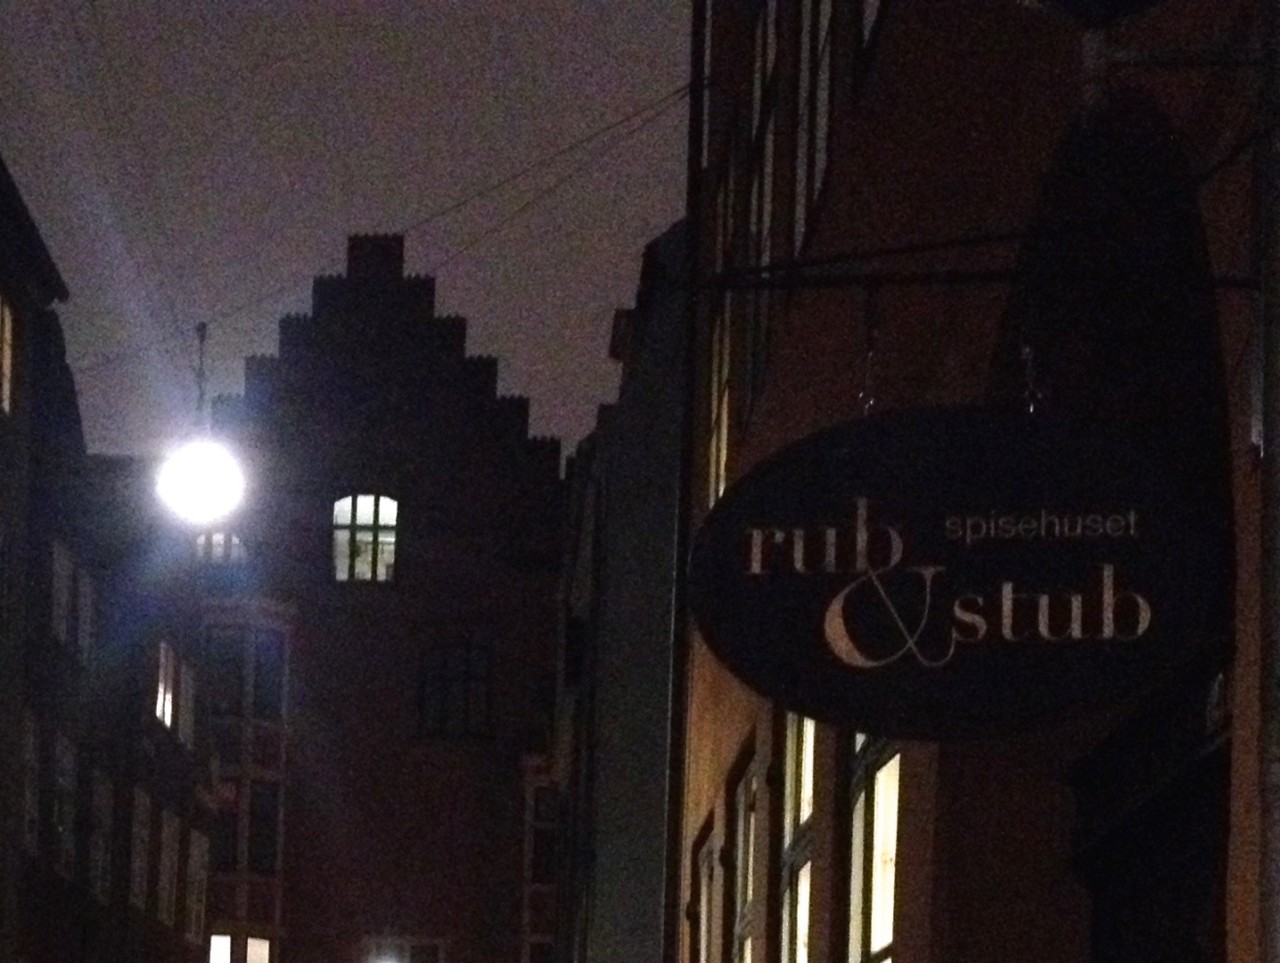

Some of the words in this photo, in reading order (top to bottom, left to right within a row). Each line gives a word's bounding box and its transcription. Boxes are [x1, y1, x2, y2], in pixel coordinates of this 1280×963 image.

[745, 497, 903, 574] rub
[944, 509, 1139, 543] spisehuset
[953, 564, 1152, 642] stub
